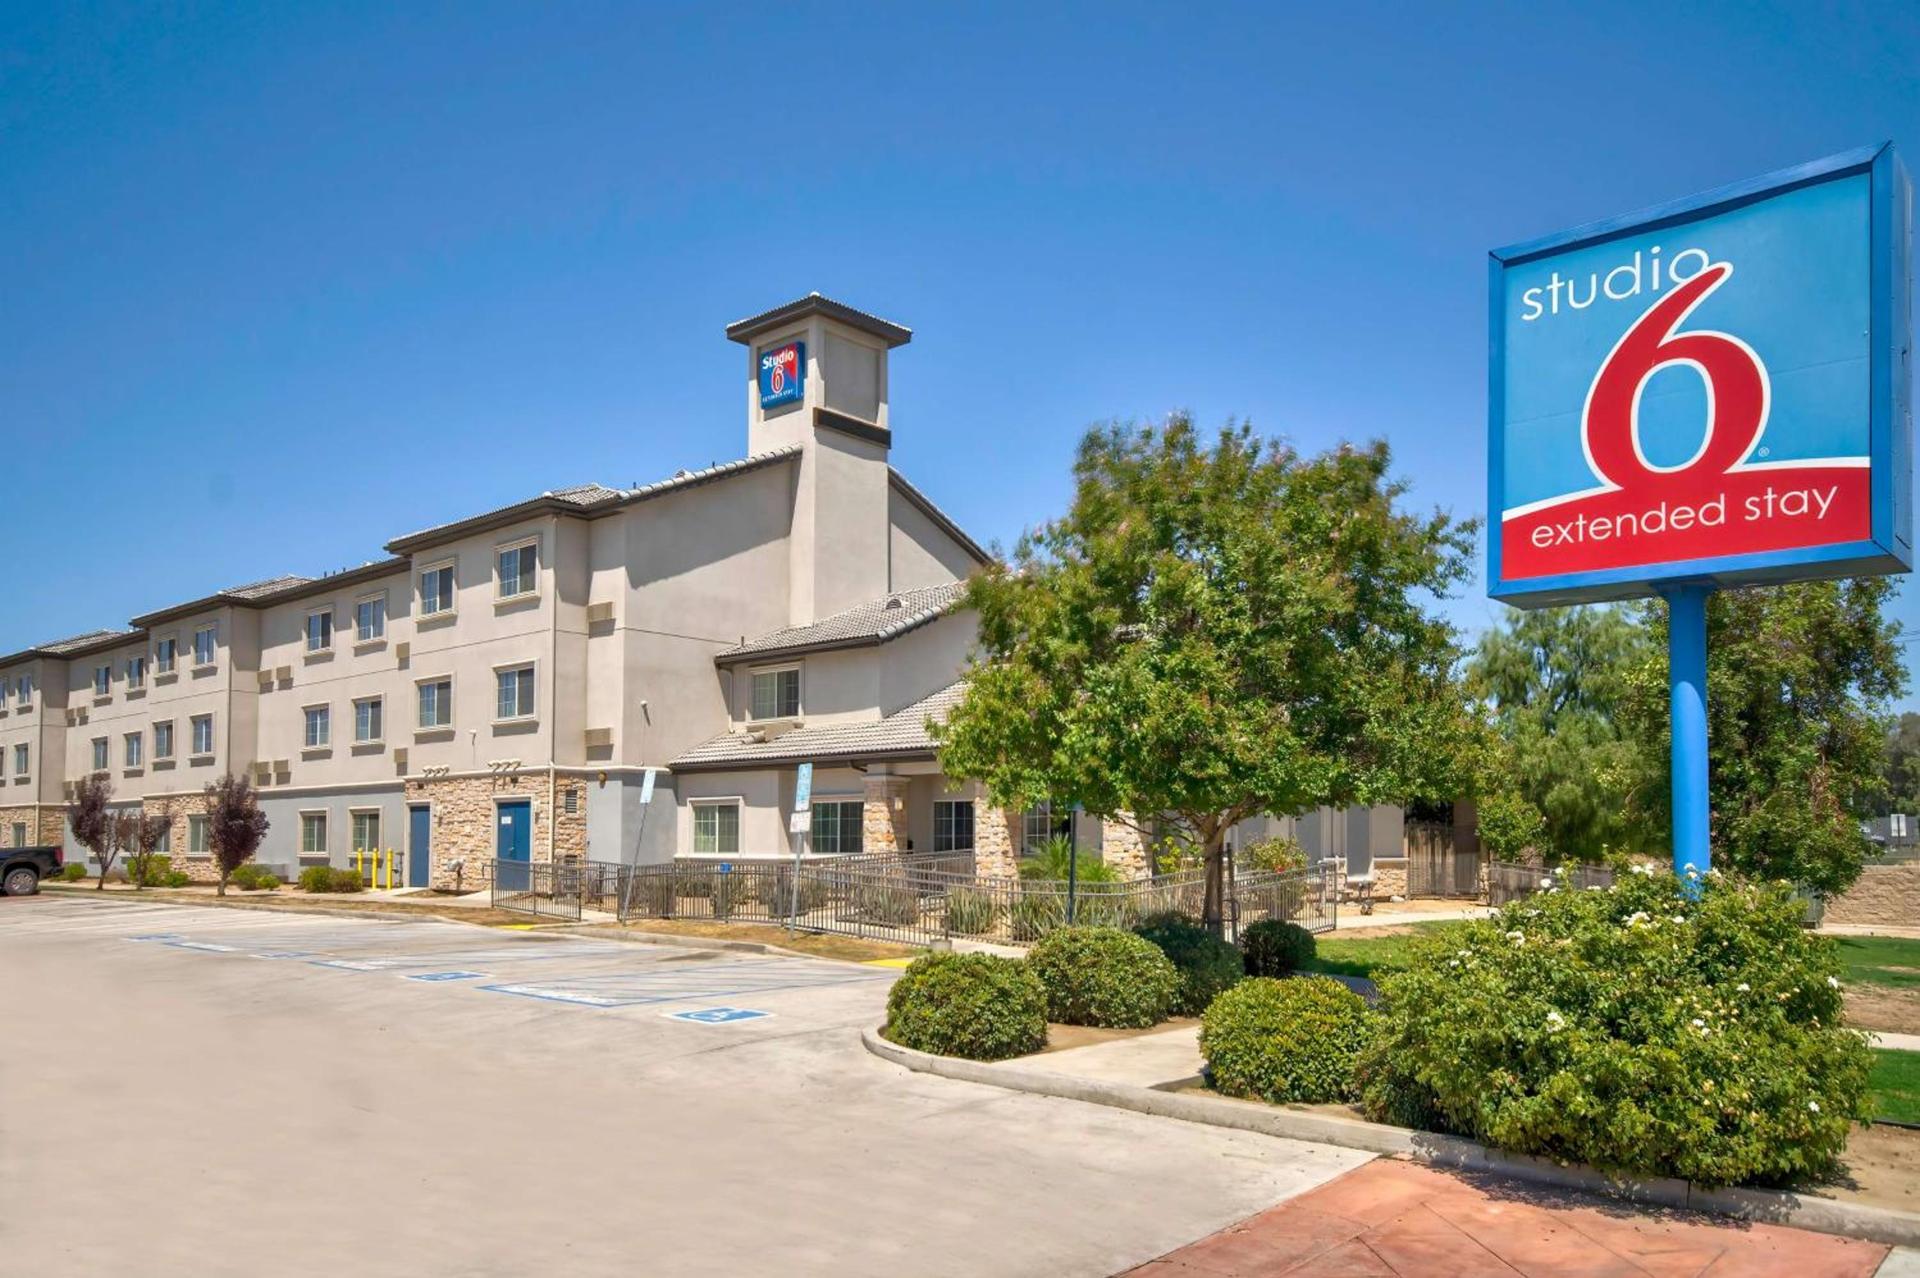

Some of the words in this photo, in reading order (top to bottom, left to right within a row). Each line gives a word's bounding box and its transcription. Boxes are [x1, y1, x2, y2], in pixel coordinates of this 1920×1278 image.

[1520, 245, 1710, 321] studio
[762, 348, 794, 369] Studio
[771, 364, 784, 394] 6
[1581, 261, 1771, 478] 6
[1530, 493, 1726, 548] extended
[1744, 485, 1838, 522] stay
